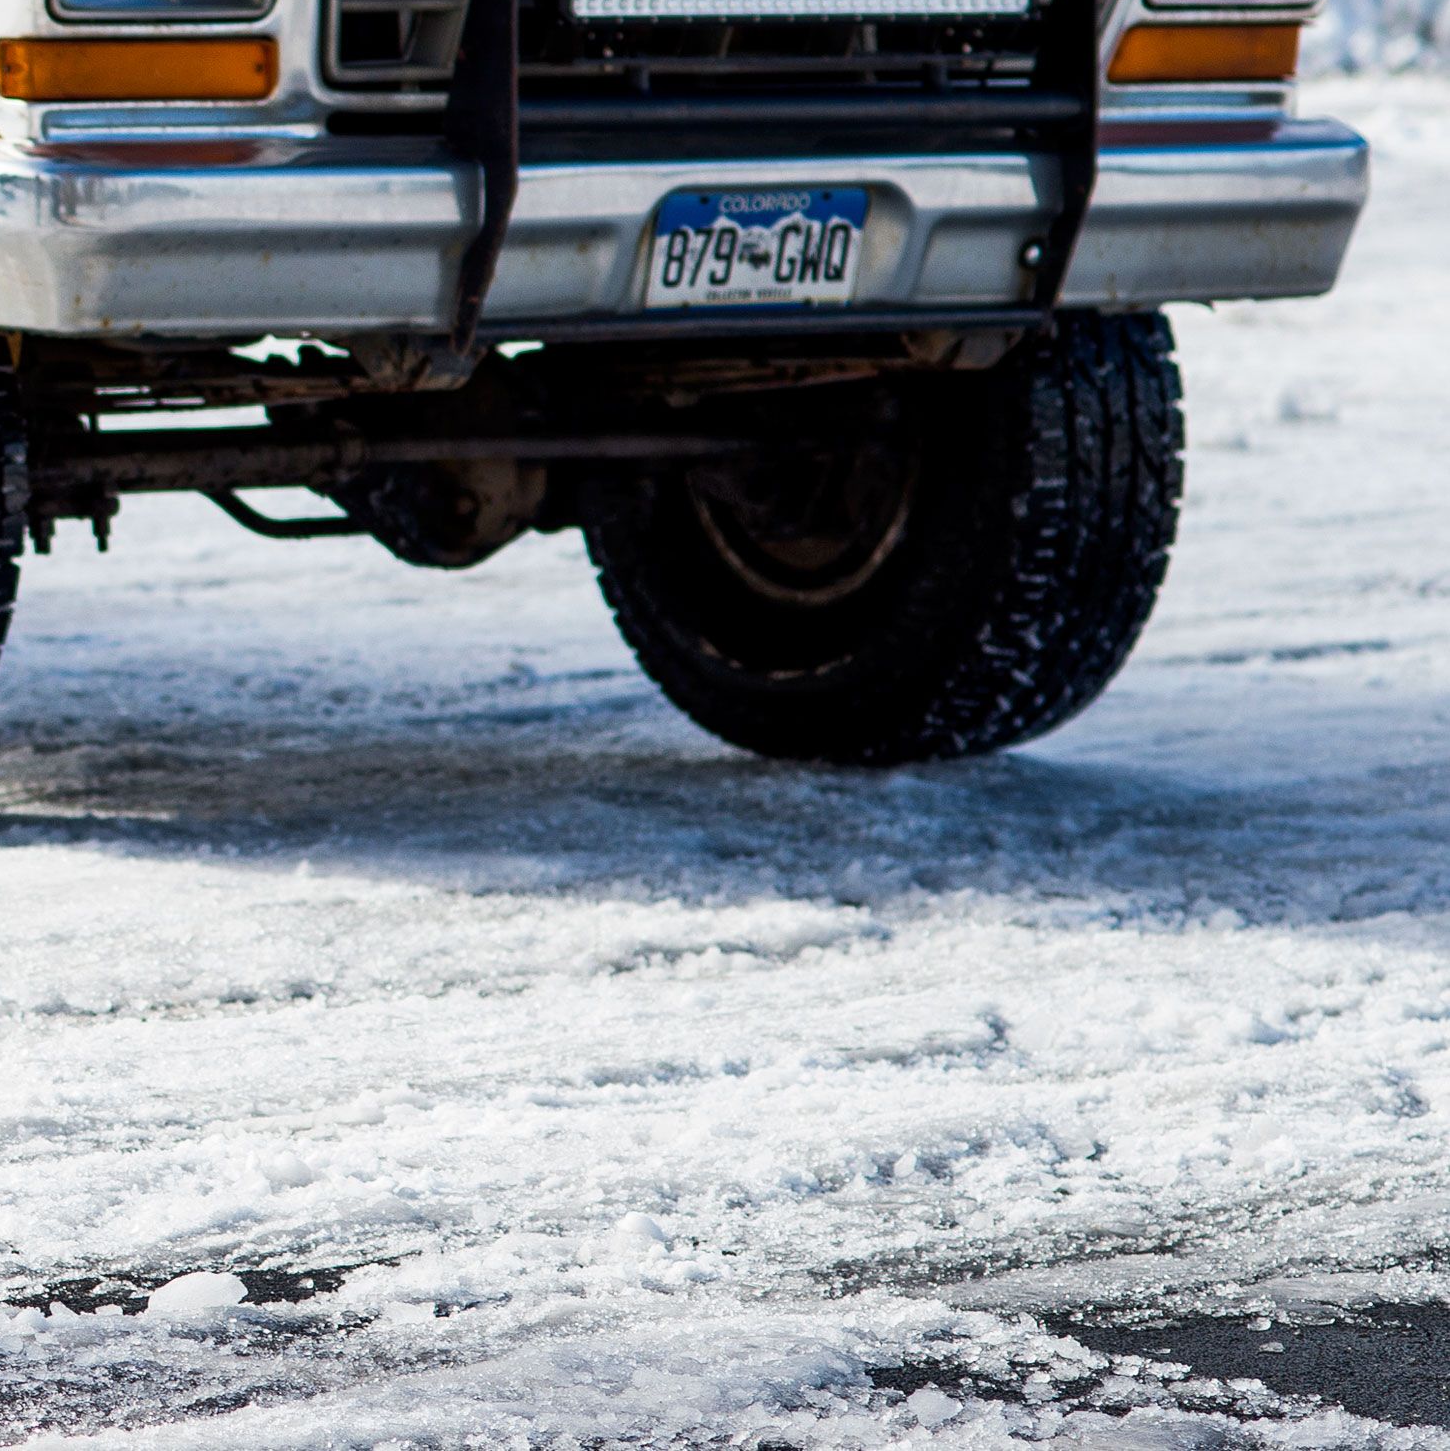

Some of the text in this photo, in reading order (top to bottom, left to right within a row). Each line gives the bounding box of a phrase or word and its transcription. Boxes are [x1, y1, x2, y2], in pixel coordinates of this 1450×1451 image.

[718, 192, 811, 214] COLORADO
[662, 223, 850, 288] 879 GWQ
